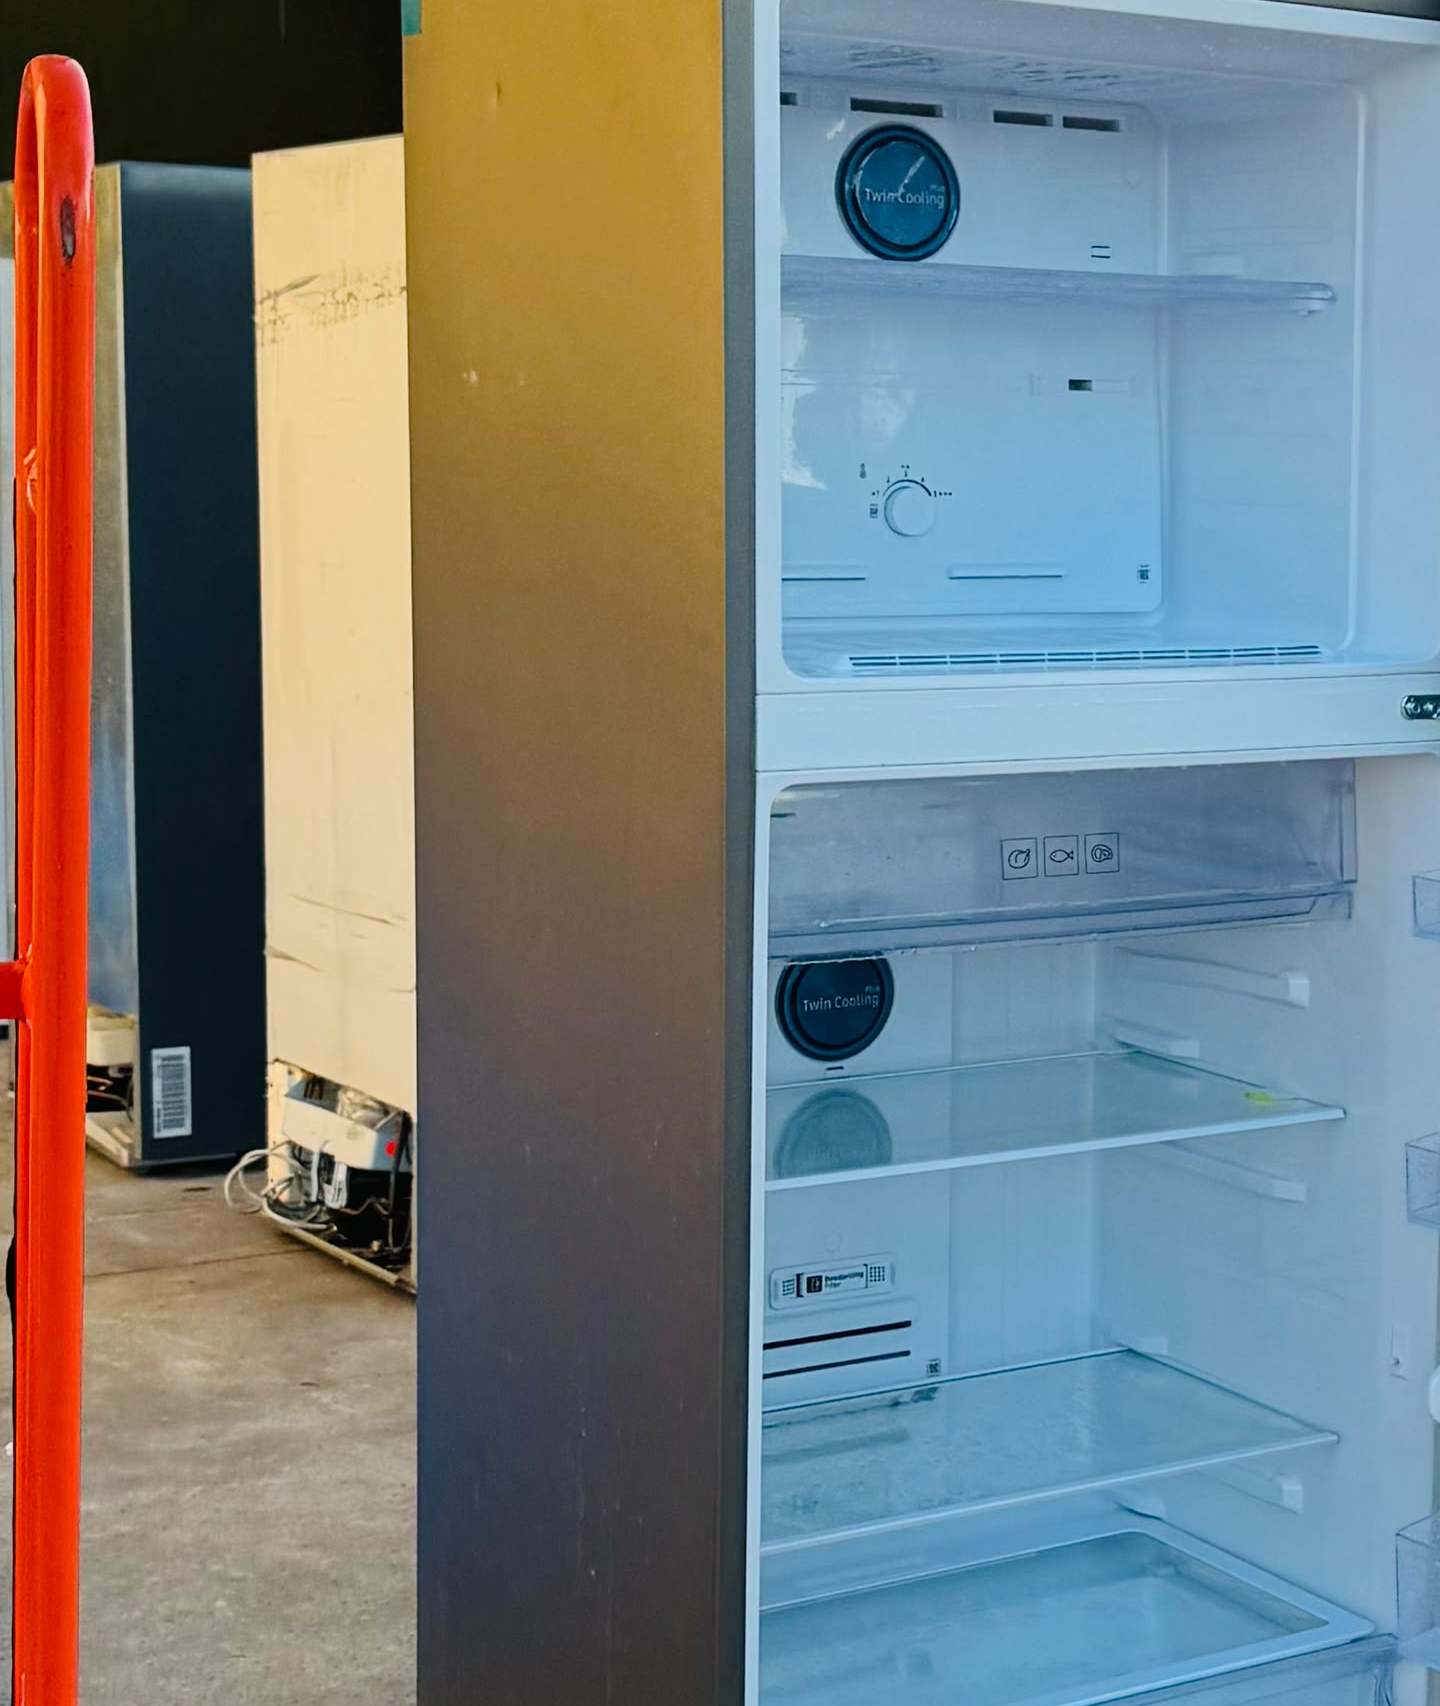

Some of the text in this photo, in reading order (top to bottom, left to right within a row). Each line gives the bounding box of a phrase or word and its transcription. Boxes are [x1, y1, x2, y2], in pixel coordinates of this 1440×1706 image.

[864, 188, 945, 209] Twin Cooling
[803, 994, 879, 1012] Twin Cooling
